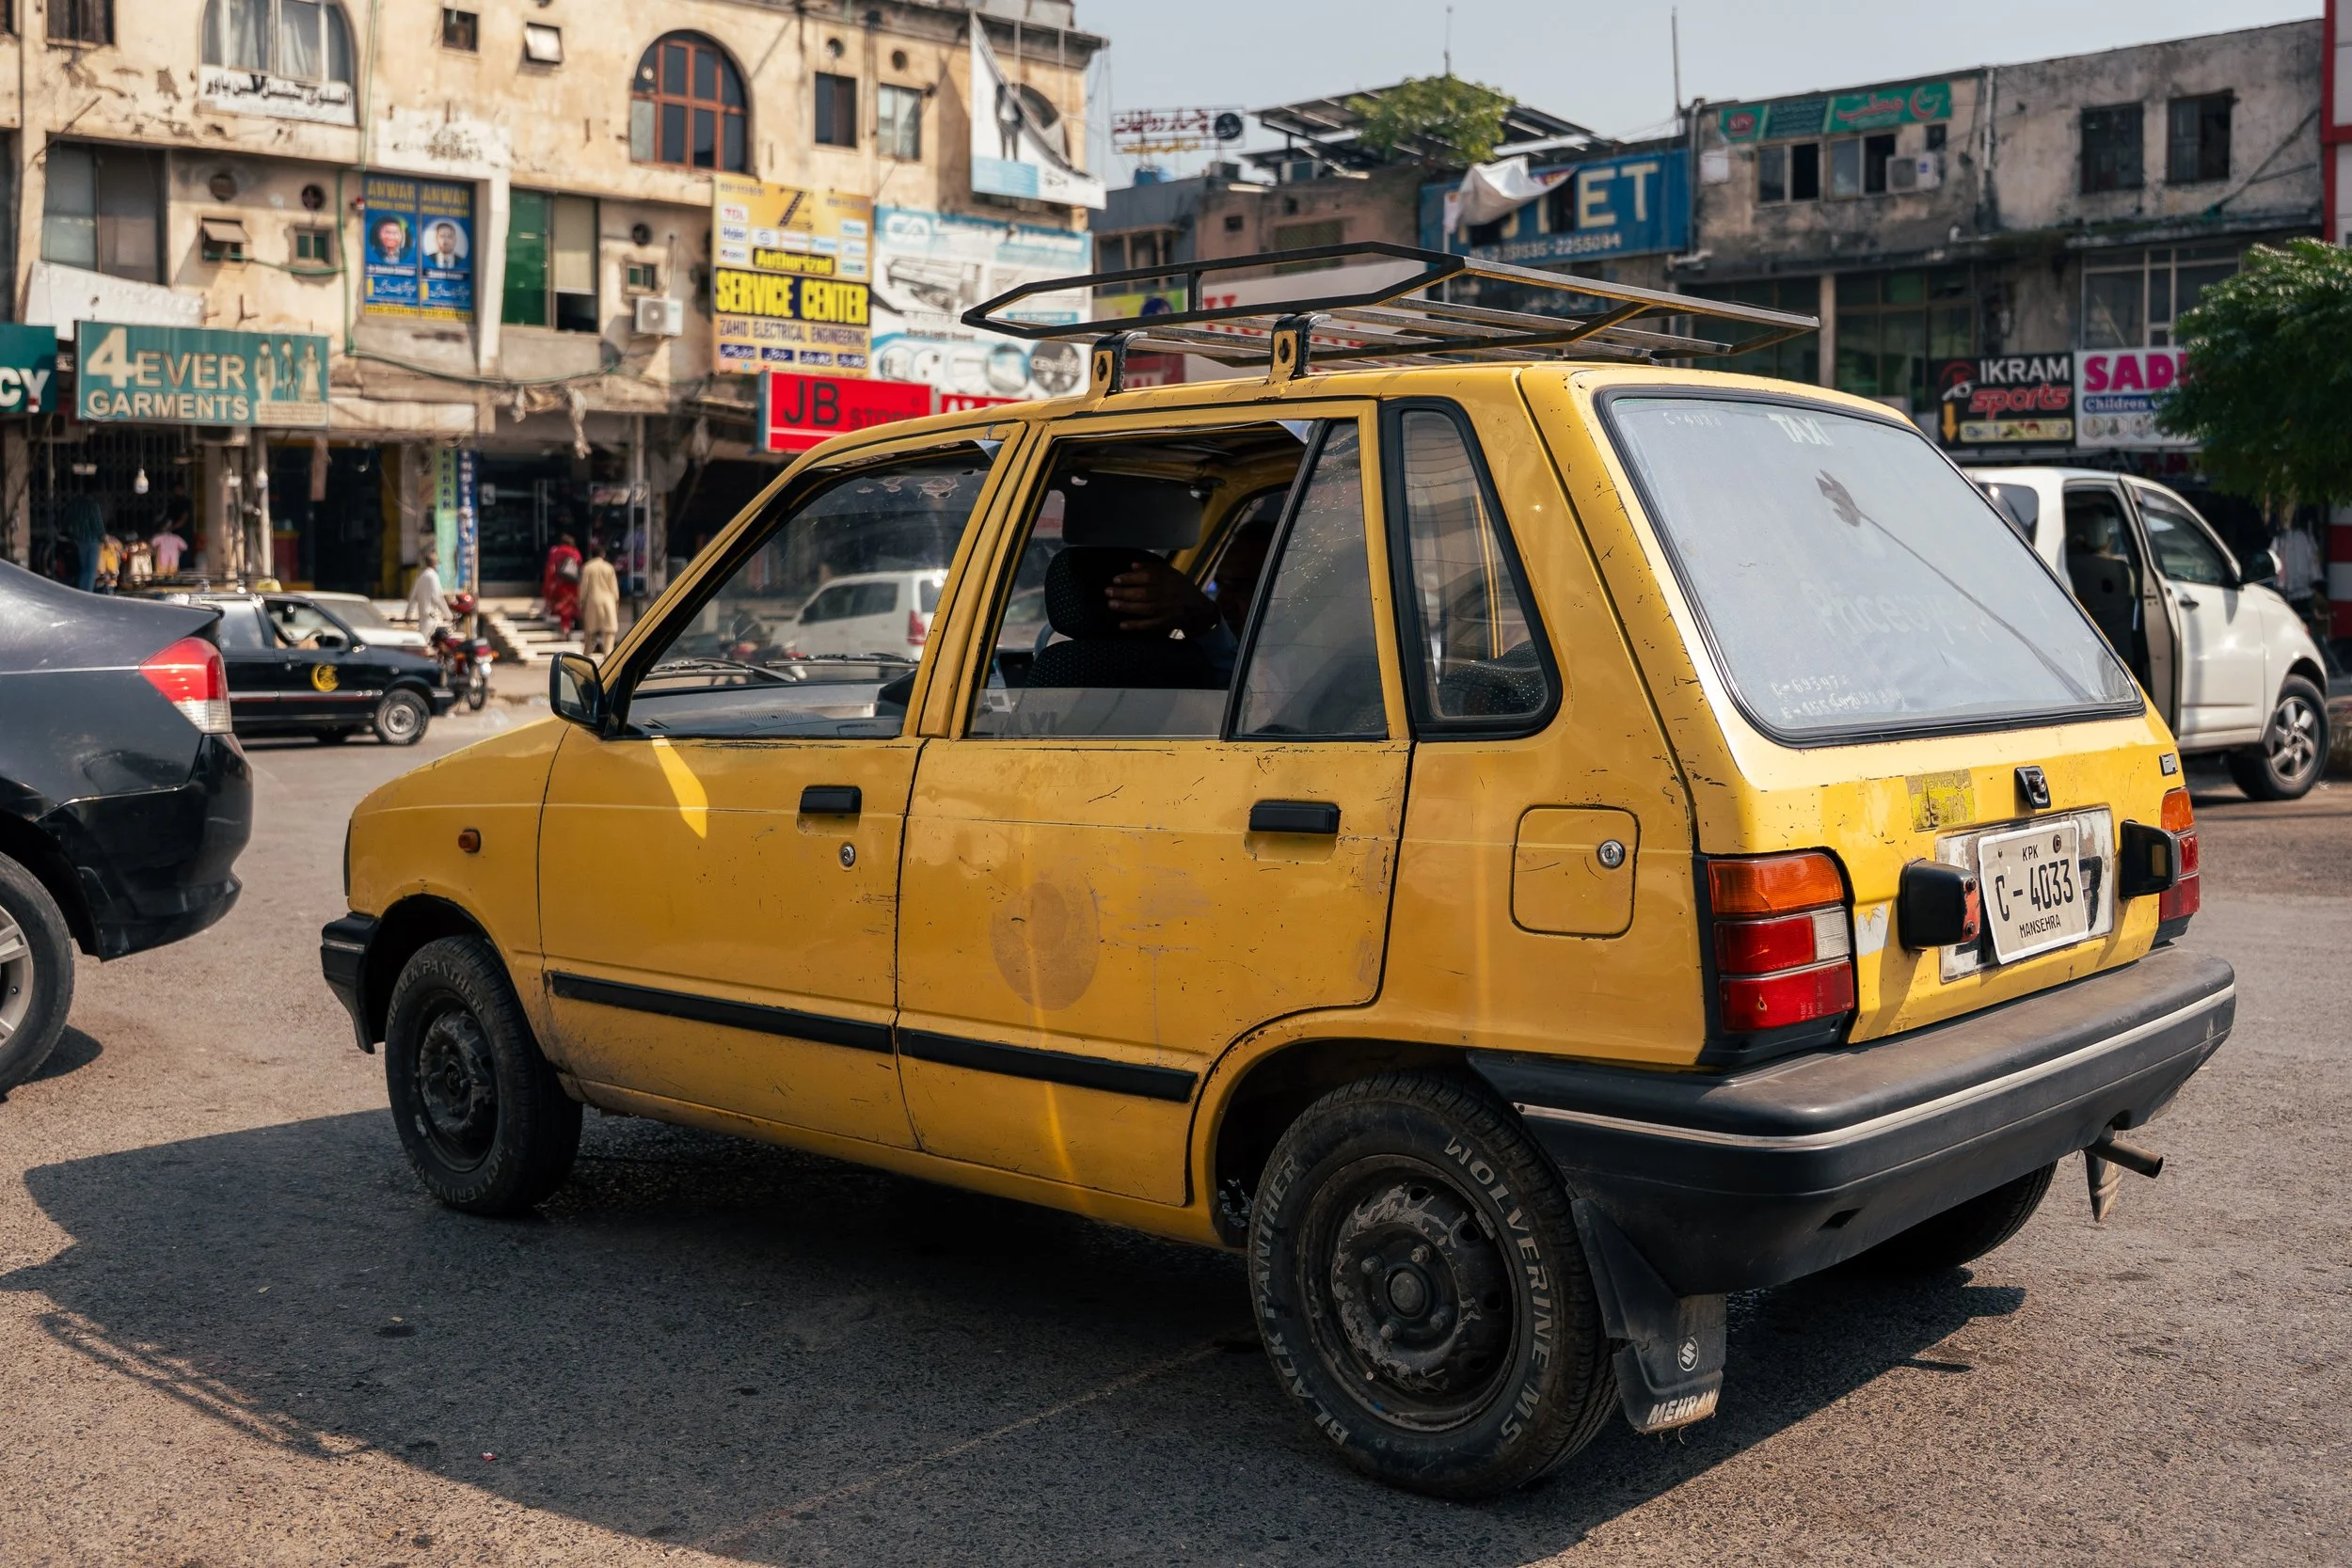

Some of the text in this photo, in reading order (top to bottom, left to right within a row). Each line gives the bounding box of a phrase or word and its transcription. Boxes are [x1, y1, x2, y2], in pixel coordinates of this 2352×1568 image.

[367, 180, 415, 202] ANWAR
[755, 248, 834, 276] Authorized
[716, 269, 869, 325] SERVICE CENTER
[720, 319, 866, 347] ZAHID ELECTRICAL ENGINEERING
[1979, 356, 2069, 384] IKRAM
[87, 390, 250, 422] GARMENTS
[783, 379, 840, 426] JB
[1969, 384, 2073, 420] sports
[2084, 394, 2147, 412] Children
[1767, 413, 1834, 446] TAXI
[2022, 844, 2039, 862] KPK
[2019, 914, 2061, 938] MANSEHRA
[422, 958, 485, 1014] PANTHER
[1443, 1136, 1552, 1370] WOLVERINE
[1256, 1154, 1350, 1446] BLACK PANTHER
[1646, 1388, 1716, 1425] MEHRAN
